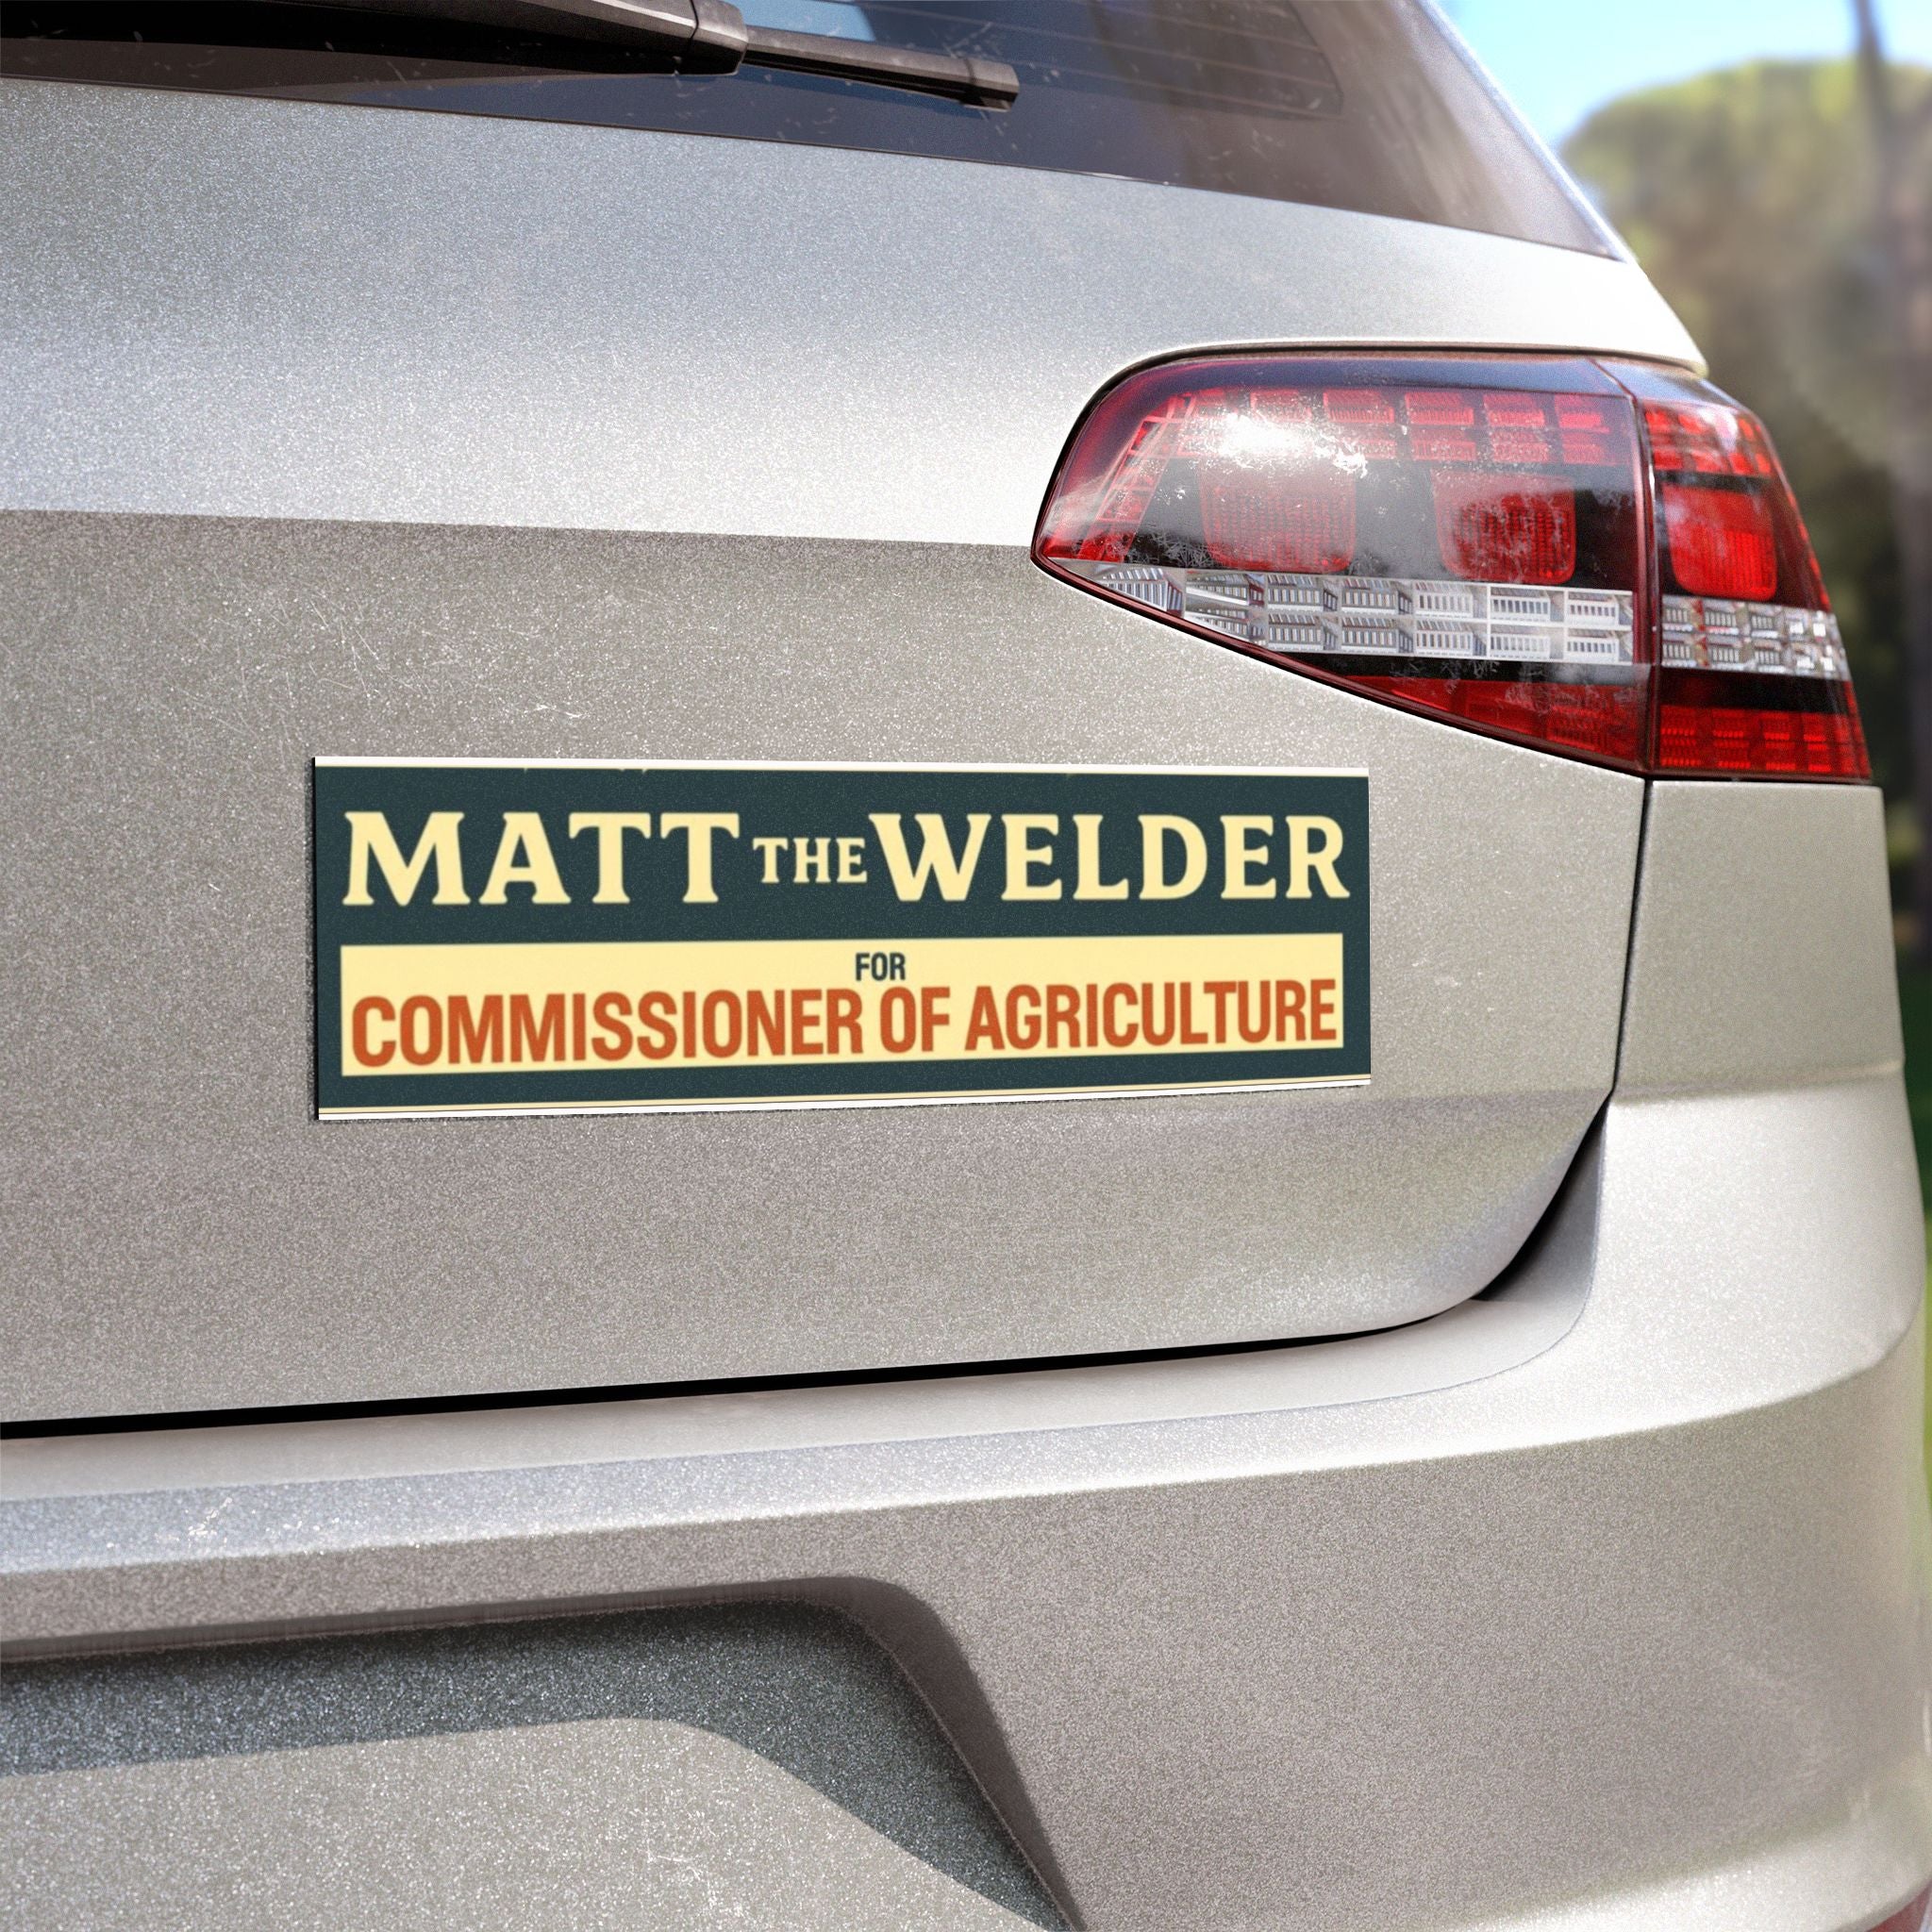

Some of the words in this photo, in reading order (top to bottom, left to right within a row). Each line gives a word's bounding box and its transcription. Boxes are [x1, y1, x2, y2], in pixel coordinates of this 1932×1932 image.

[341, 810, 741, 907] MATT
[752, 836, 867, 885] THE
[868, 812, 1351, 902] WELDER
[855, 952, 906, 982] FOR
[351, 989, 863, 1068] COMMISSIONER
[879, 986, 951, 1056] OF
[964, 978, 1337, 1052] AGRICULTURE
